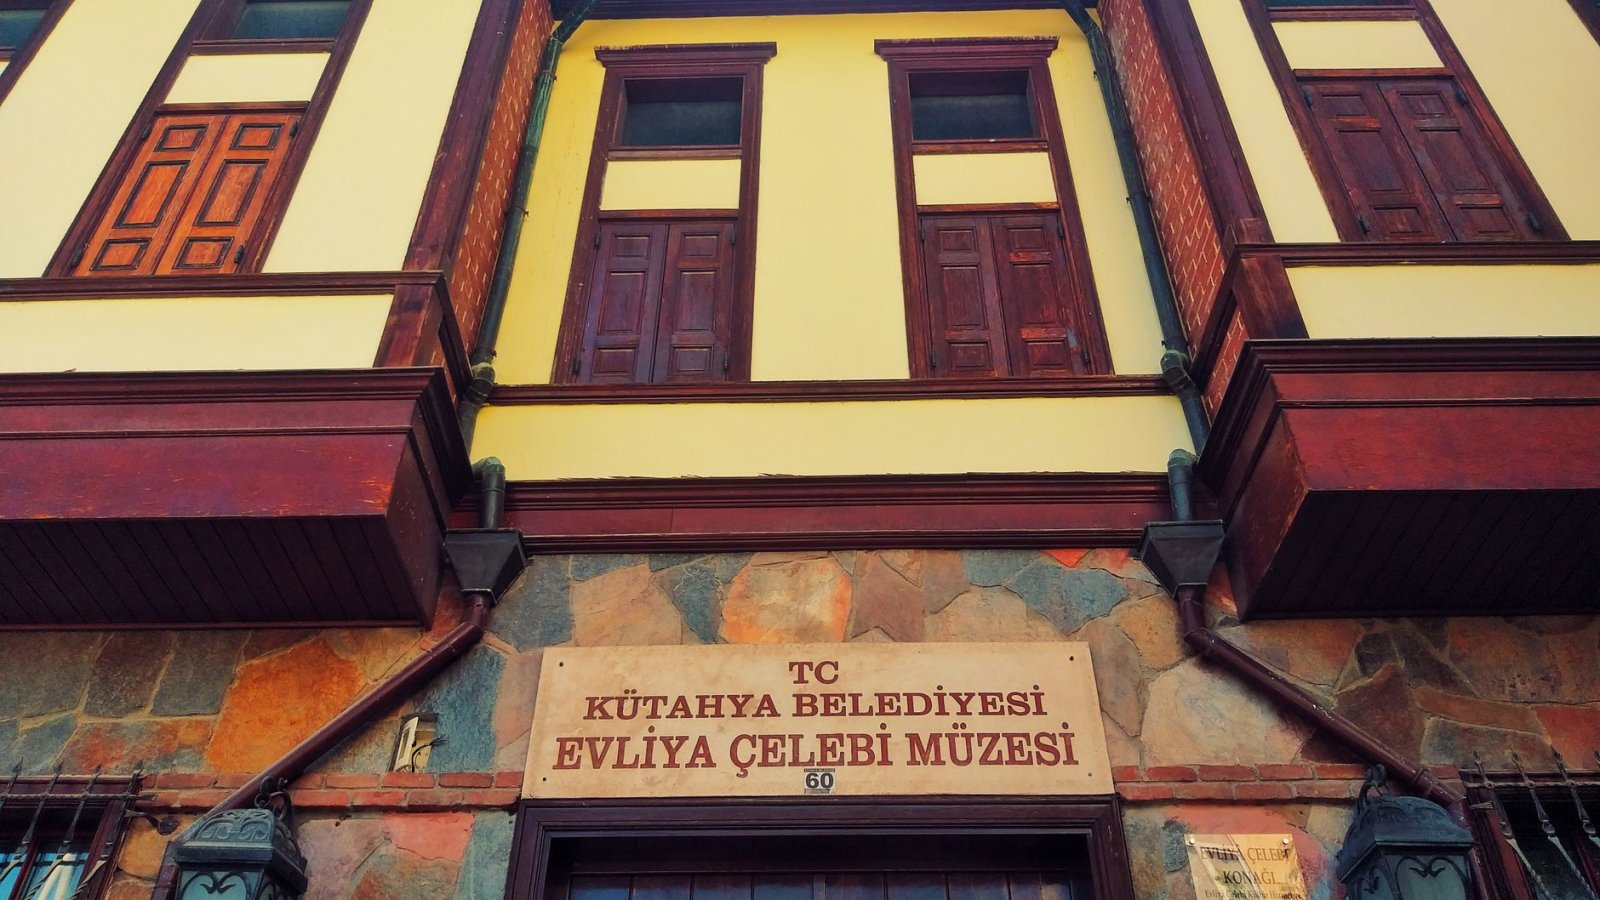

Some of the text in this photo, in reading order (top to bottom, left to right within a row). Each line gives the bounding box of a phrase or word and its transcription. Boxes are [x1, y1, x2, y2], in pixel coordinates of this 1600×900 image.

[789, 661, 839, 684] TC
[583, 685, 1048, 720] KÜTAHYA BELEDİYESİ
[552, 722, 1079, 778] EVLİYA ÇELEBİ MÜZESİ
[805, 772, 834, 789] 60
